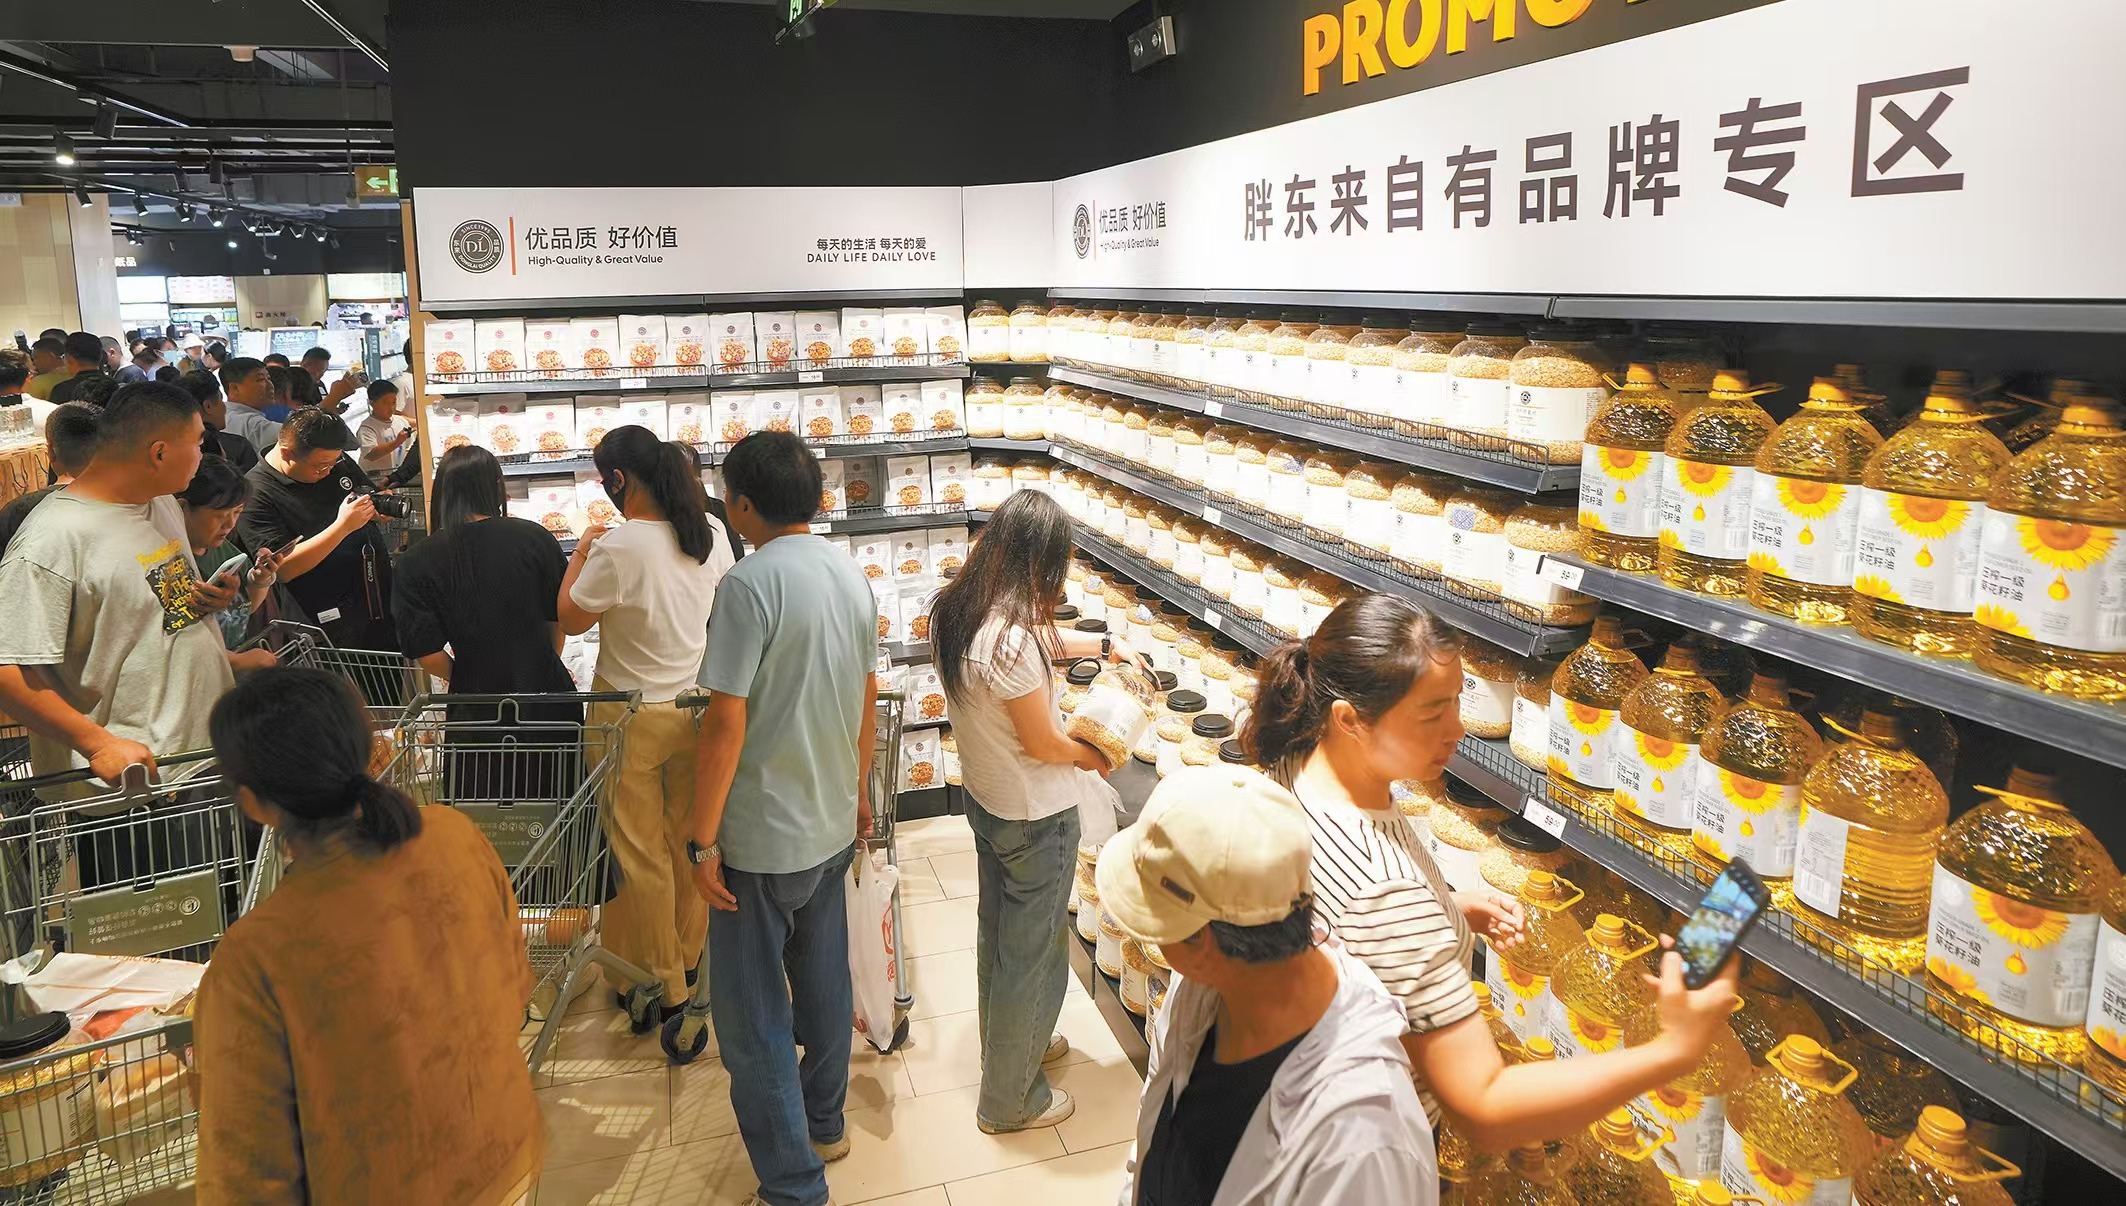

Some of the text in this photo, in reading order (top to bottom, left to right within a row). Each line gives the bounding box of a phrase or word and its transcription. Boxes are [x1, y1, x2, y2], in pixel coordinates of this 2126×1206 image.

[1244, 66, 1969, 242] 胖东来自有品牌专区
[1133, 201, 1166, 230] 好价值
[525, 227, 598, 250] 优品质
[608, 225, 678, 249] 好价值
[816, 237, 927, 251] 每天的生活 每天的爱
[528, 254, 663, 267] High-Quality & Great Value
[807, 251, 936, 263] DAILY LIFE DAILY LOVE
